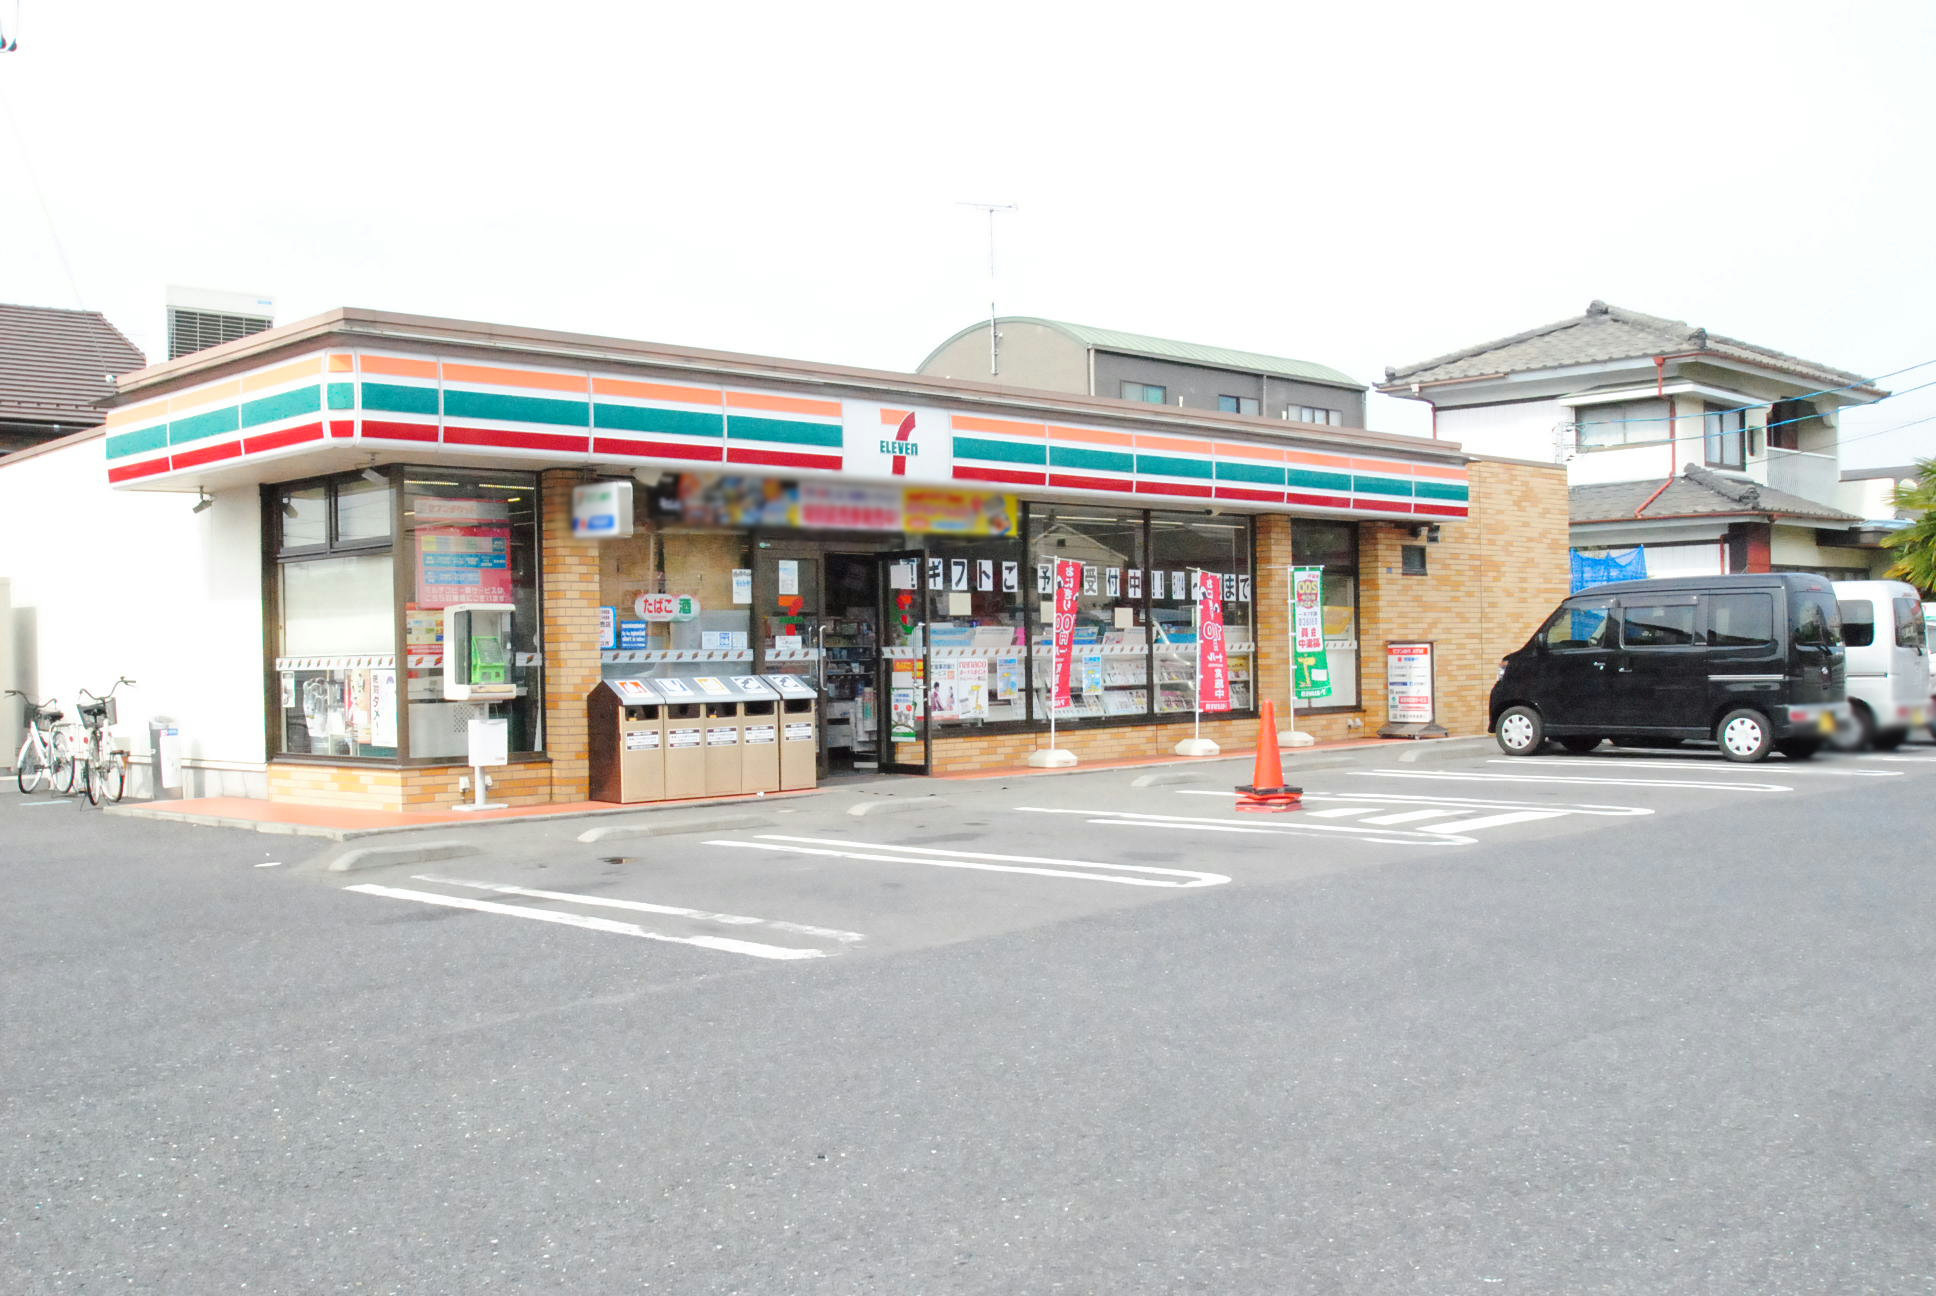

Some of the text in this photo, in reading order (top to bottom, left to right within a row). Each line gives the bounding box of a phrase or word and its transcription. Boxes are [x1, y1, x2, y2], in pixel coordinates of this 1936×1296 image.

[643, 598, 692, 614] たばこ 酒
